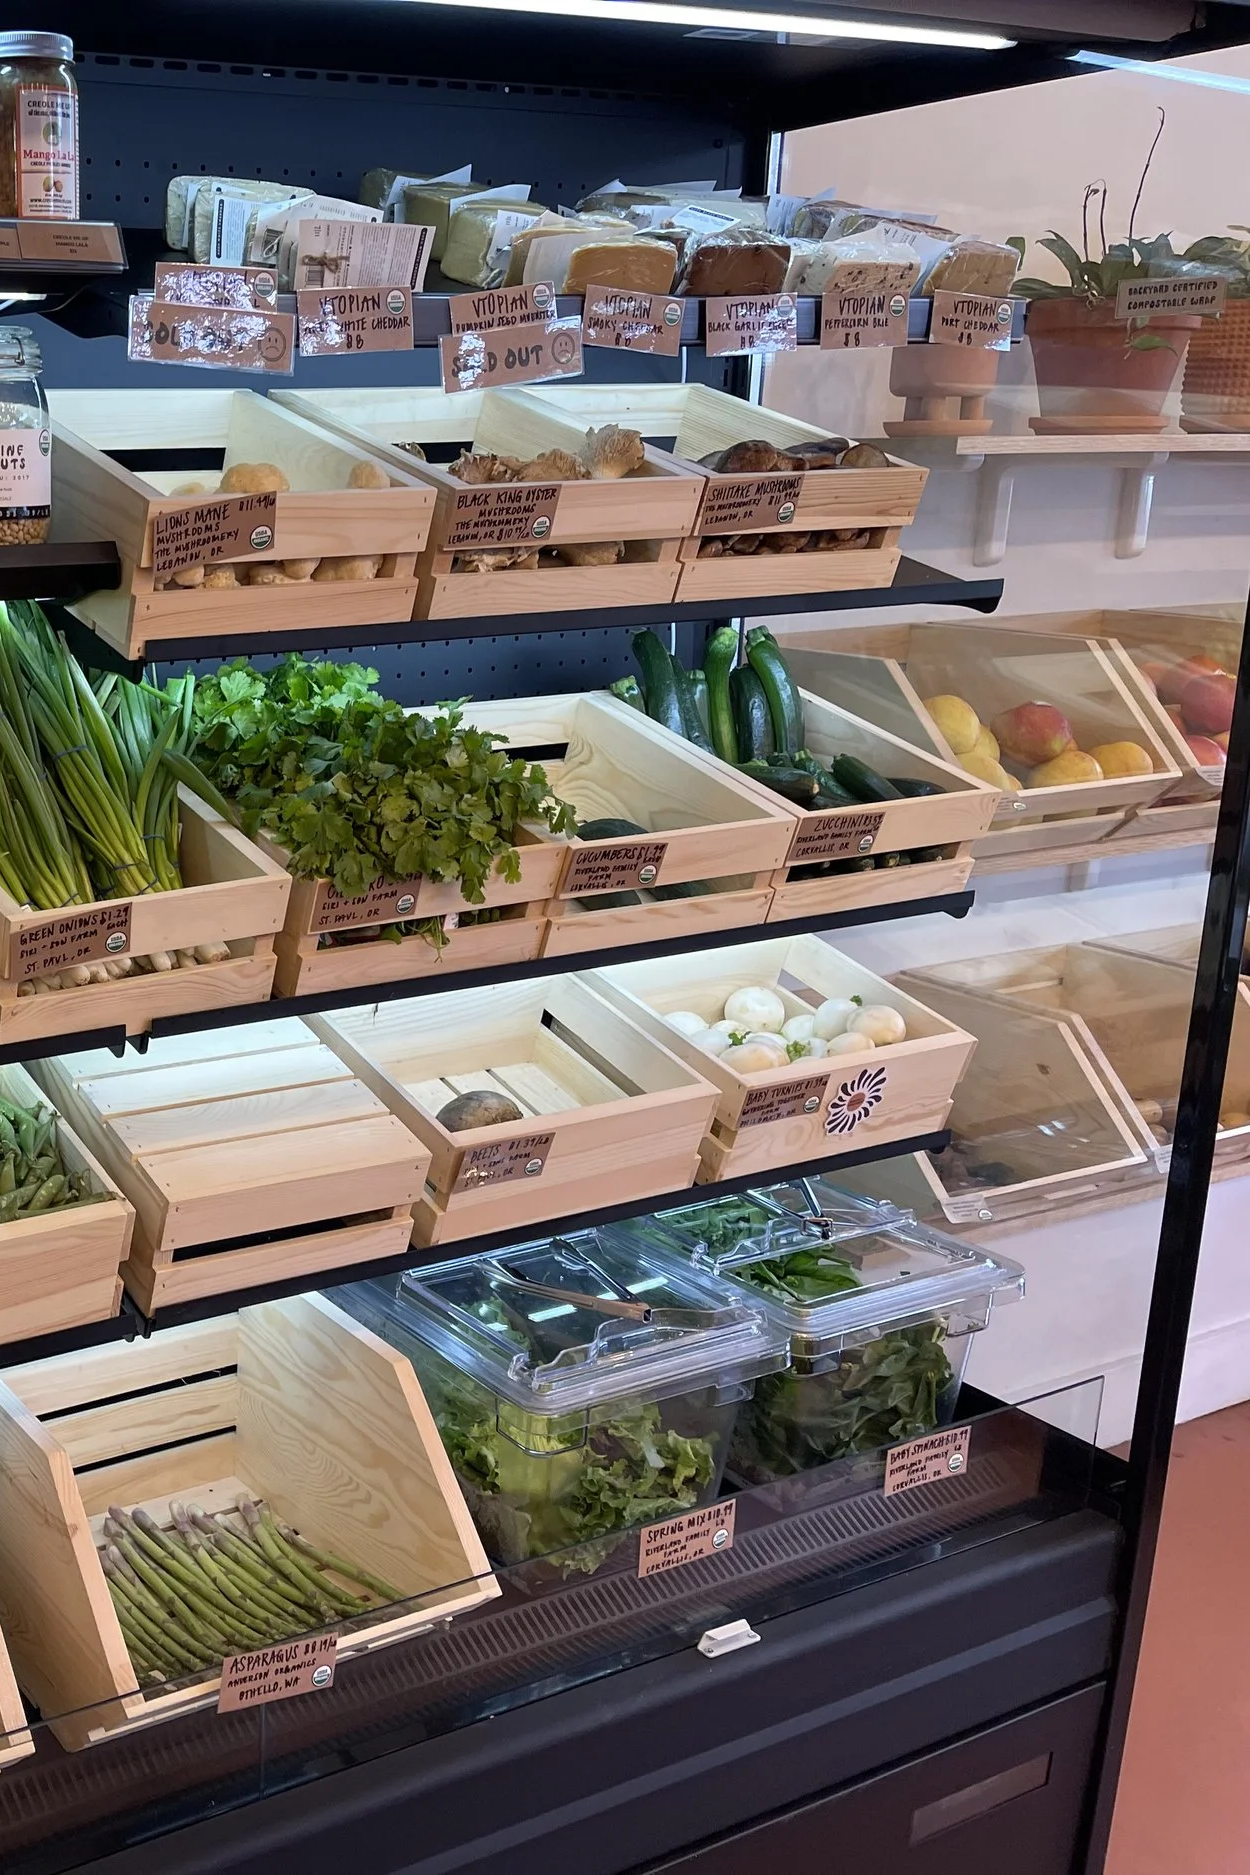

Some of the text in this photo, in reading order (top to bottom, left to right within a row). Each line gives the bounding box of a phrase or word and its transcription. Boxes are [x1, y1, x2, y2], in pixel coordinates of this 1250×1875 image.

[23, 149, 56, 161] Mango
[1128, 280, 1218, 297] BACKYARD CERTIFIED
[472, 291, 528, 319] VTOPIAN
[839, 294, 885, 316] VTOPIAN
[953, 299, 997, 317] VTOPIAN
[1127, 295, 1216, 311] COMPOSTABLE WRAP
[371, 316, 410, 331] CHEDDAR
[456, 310, 556, 333] PUMPKIN SEED MUENSTER
[587, 316, 617, 332] SMOKY
[708, 322, 731, 333] BLACK
[824, 317, 889, 330] PEPPERCORN BRIE
[941, 316, 1000, 332] PORT CHEDDAR
[504, 344, 544, 370] OUT
[708, 477, 802, 502] SHIITAKE MUSHROOMS
[457, 488, 557, 510] BLACK KING OYSTER
[156, 503, 231, 535] LIONS MANE
[477, 503, 537, 519] MUSHROOMS
[743, 510, 754, 519] OR
[156, 521, 221, 547] MUSHROOMS
[455, 519, 472, 531] THE
[155, 528, 240, 560] THE MUSHROOMERY
[483, 531, 495, 539] OR
[210, 546, 225, 557] OR
[838, 842, 850, 851] OR
[575, 847, 638, 865] CUCUMBERS
[351, 889, 398, 906] SON FARM
[366, 908, 381, 918] OR
[19, 913, 99, 946] GREEN ONIONS
[20, 929, 98, 960] SIRI SON FARM
[77, 946, 92, 957] OR
[745, 1079, 805, 1107] BABY TURNIPS
[470, 1143, 502, 1164] BEETS
[890, 1435, 945, 1466] BABY SPINACH
[889, 1458, 923, 1478] RIVERLAND
[646, 1512, 706, 1544] SPRING MIX
[645, 1528, 711, 1557] RIVERLAND FAMILY
[663, 1544, 687, 1558] FARM
[693, 1547, 705, 1558] OR
[229, 1644, 300, 1675] ASPARAGUS
[227, 1657, 317, 1689] ANDERSON ORGANICS
[284, 1676, 301, 1689] WA
